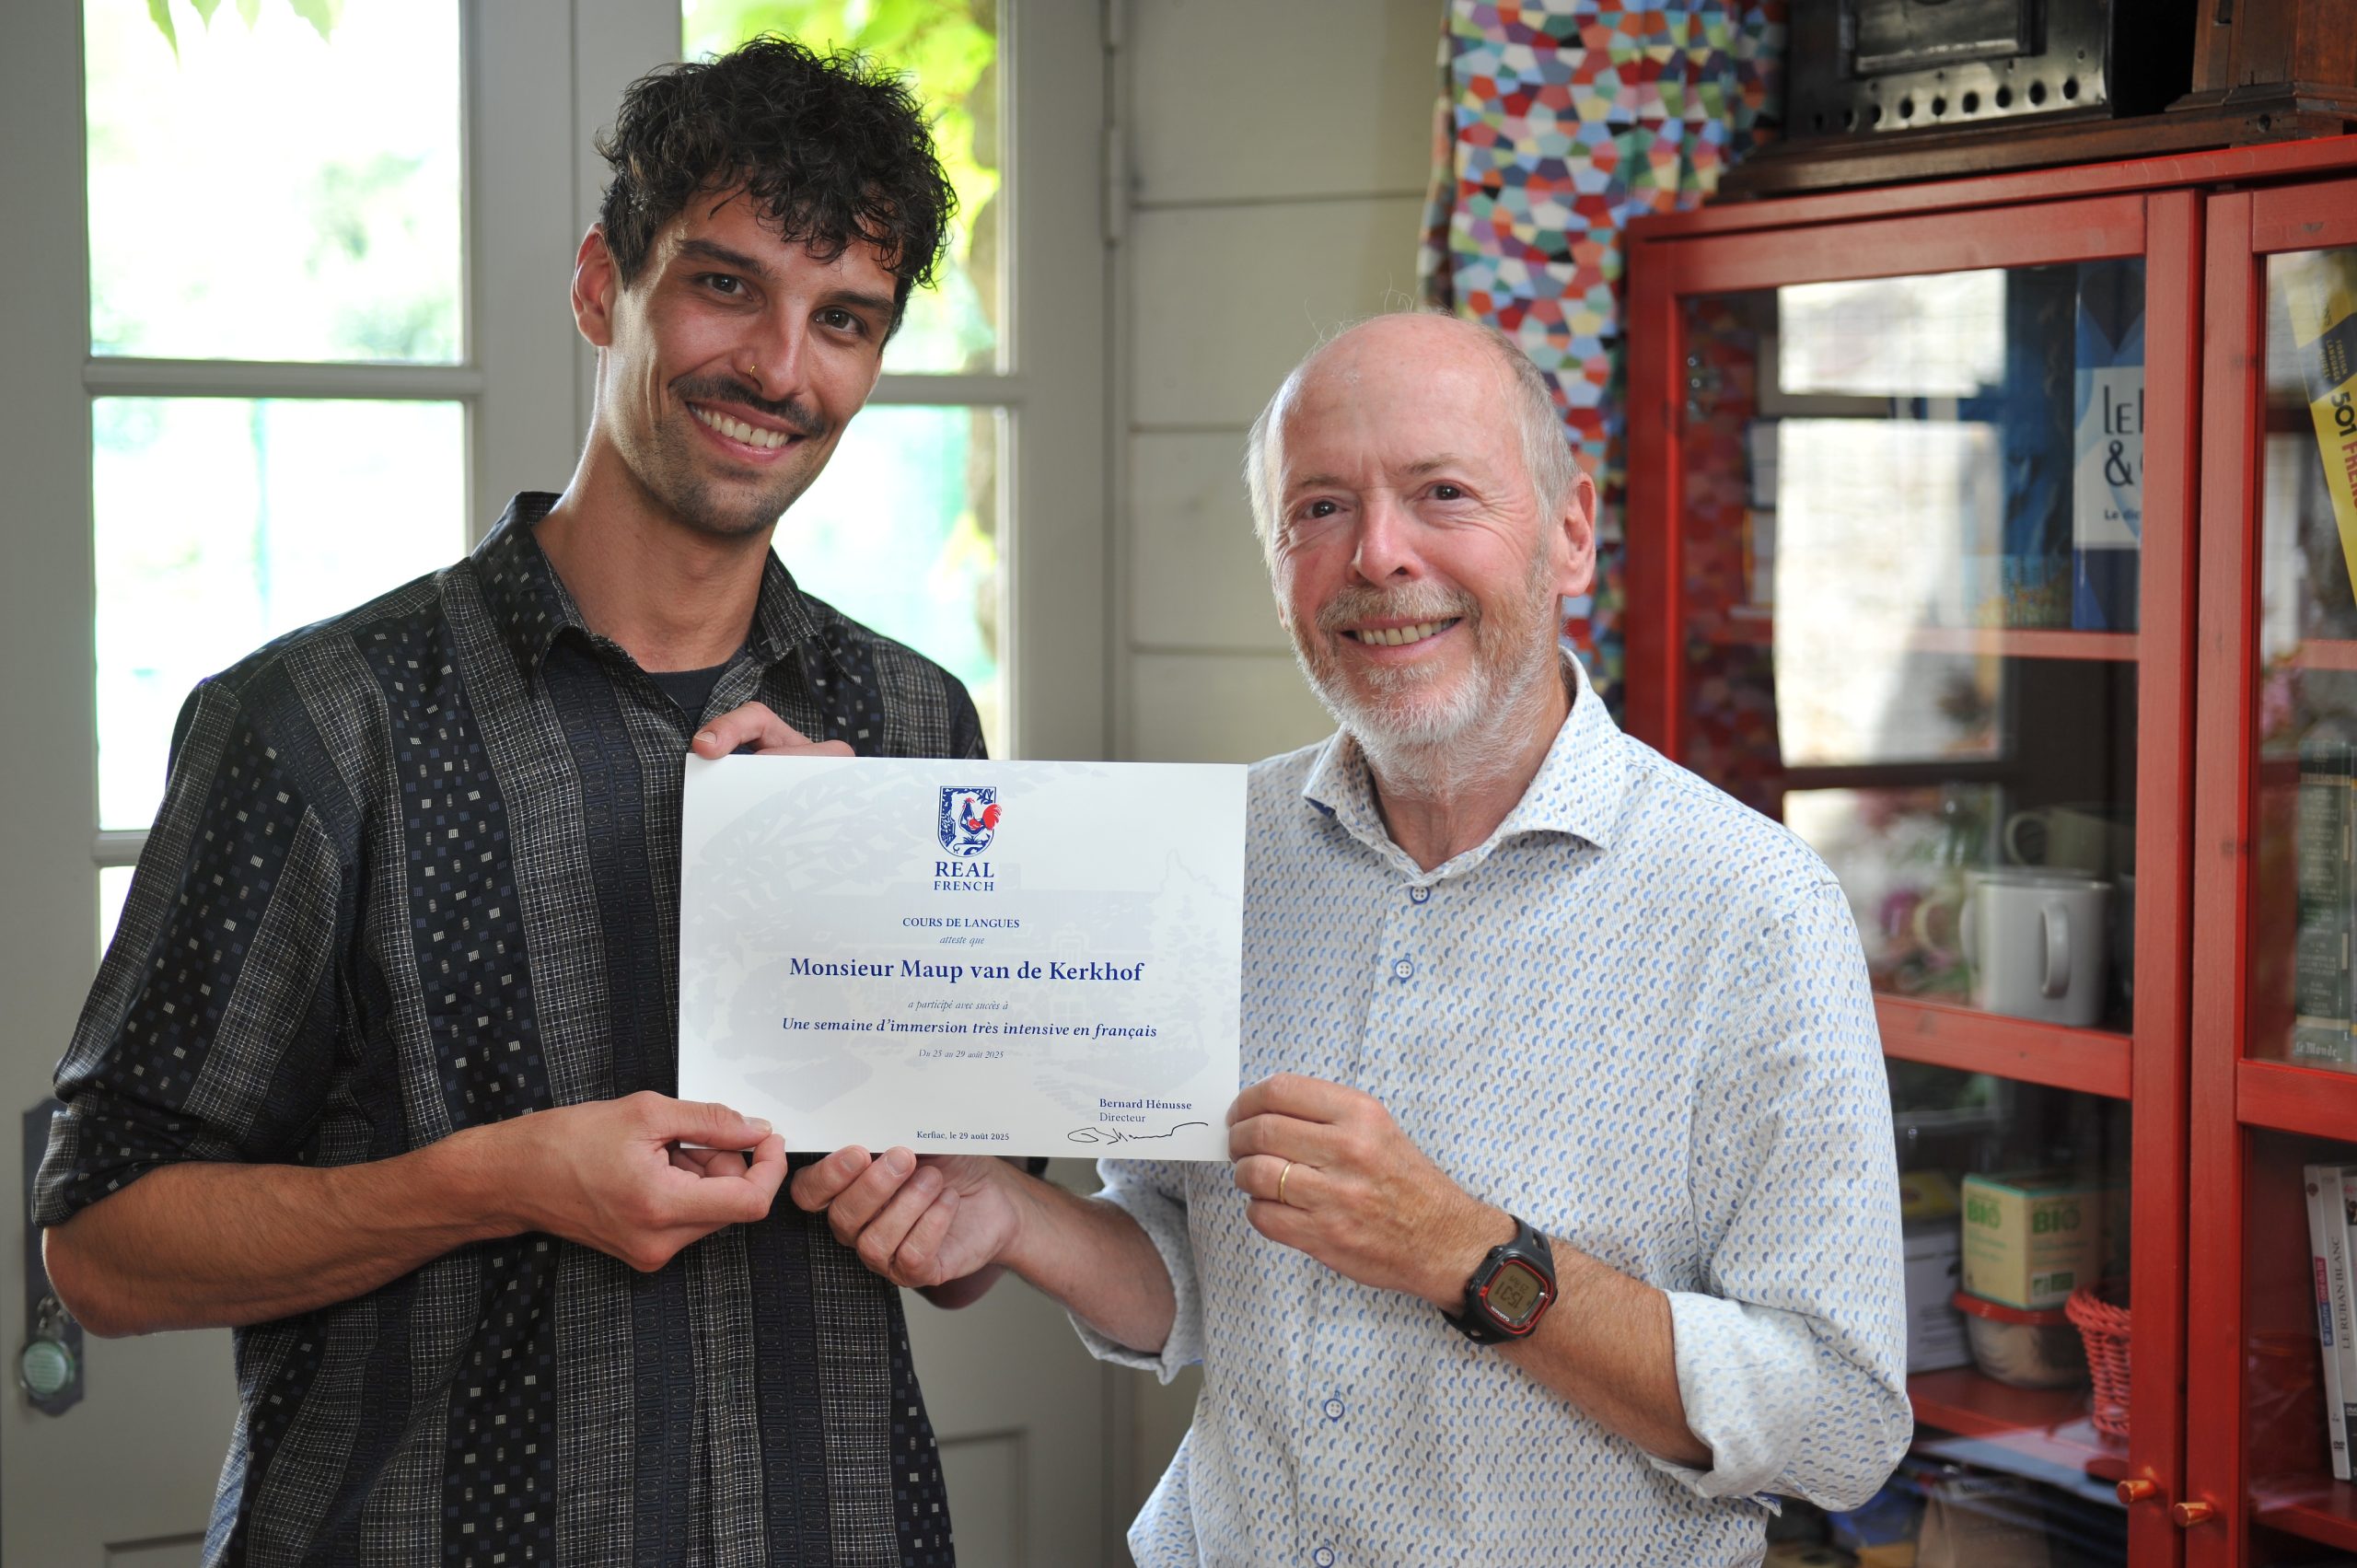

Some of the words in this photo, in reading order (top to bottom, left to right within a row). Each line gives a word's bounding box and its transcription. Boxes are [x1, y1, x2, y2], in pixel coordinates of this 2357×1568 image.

[2104, 439, 2134, 487] &
[935, 861, 995, 878] REAL
[934, 880, 994, 892] FRENCH
[902, 917, 943, 927] COURS
[946, 917, 962, 927] DE
[964, 918, 1020, 929] LANGUES
[939, 935, 968, 945] atteste
[969, 937, 985, 947] que
[789, 958, 895, 977] Monsieur
[900, 959, 963, 984] Maup
[970, 966, 1010, 980] van
[1016, 960, 1042, 980] de
[1049, 961, 1145, 981] Kerkhof
[914, 999, 954, 1013] participé
[975, 1000, 1001, 1010] succès
[1002, 1001, 1009, 1010] à
[783, 1017, 810, 1030] Une
[813, 1018, 873, 1031] semaine
[876, 1018, 968, 1034] d'immersion
[972, 1021, 999, 1034] très
[1004, 1022, 1070, 1036] intensive
[1073, 1027, 1090, 1036] en
[1091, 1023, 1157, 1040] français
[919, 1049, 932, 1058] Du
[932, 1049, 943, 1058] 25
[955, 1050, 966, 1058] 29
[984, 1051, 1004, 1059] 2025
[2305, 1041, 2338, 1058] Monde
[1099, 1098, 1143, 1109] Bernard
[1145, 1099, 1192, 1109] Hénusse
[1099, 1111, 1146, 1123] Directeur
[949, 1131, 958, 1140] le
[958, 1132, 969, 1140] 29
[991, 1132, 1010, 1141] 2025
[2032, 1206, 2082, 1235] BIO
[2330, 1237, 2344, 1281] BLANC
[1491, 1306, 1510, 1321] GARMIN
[2336, 1283, 2350, 1330] RUBAN
[2324, 1333, 2332, 1345] de
[2340, 1333, 2351, 1350] LE
